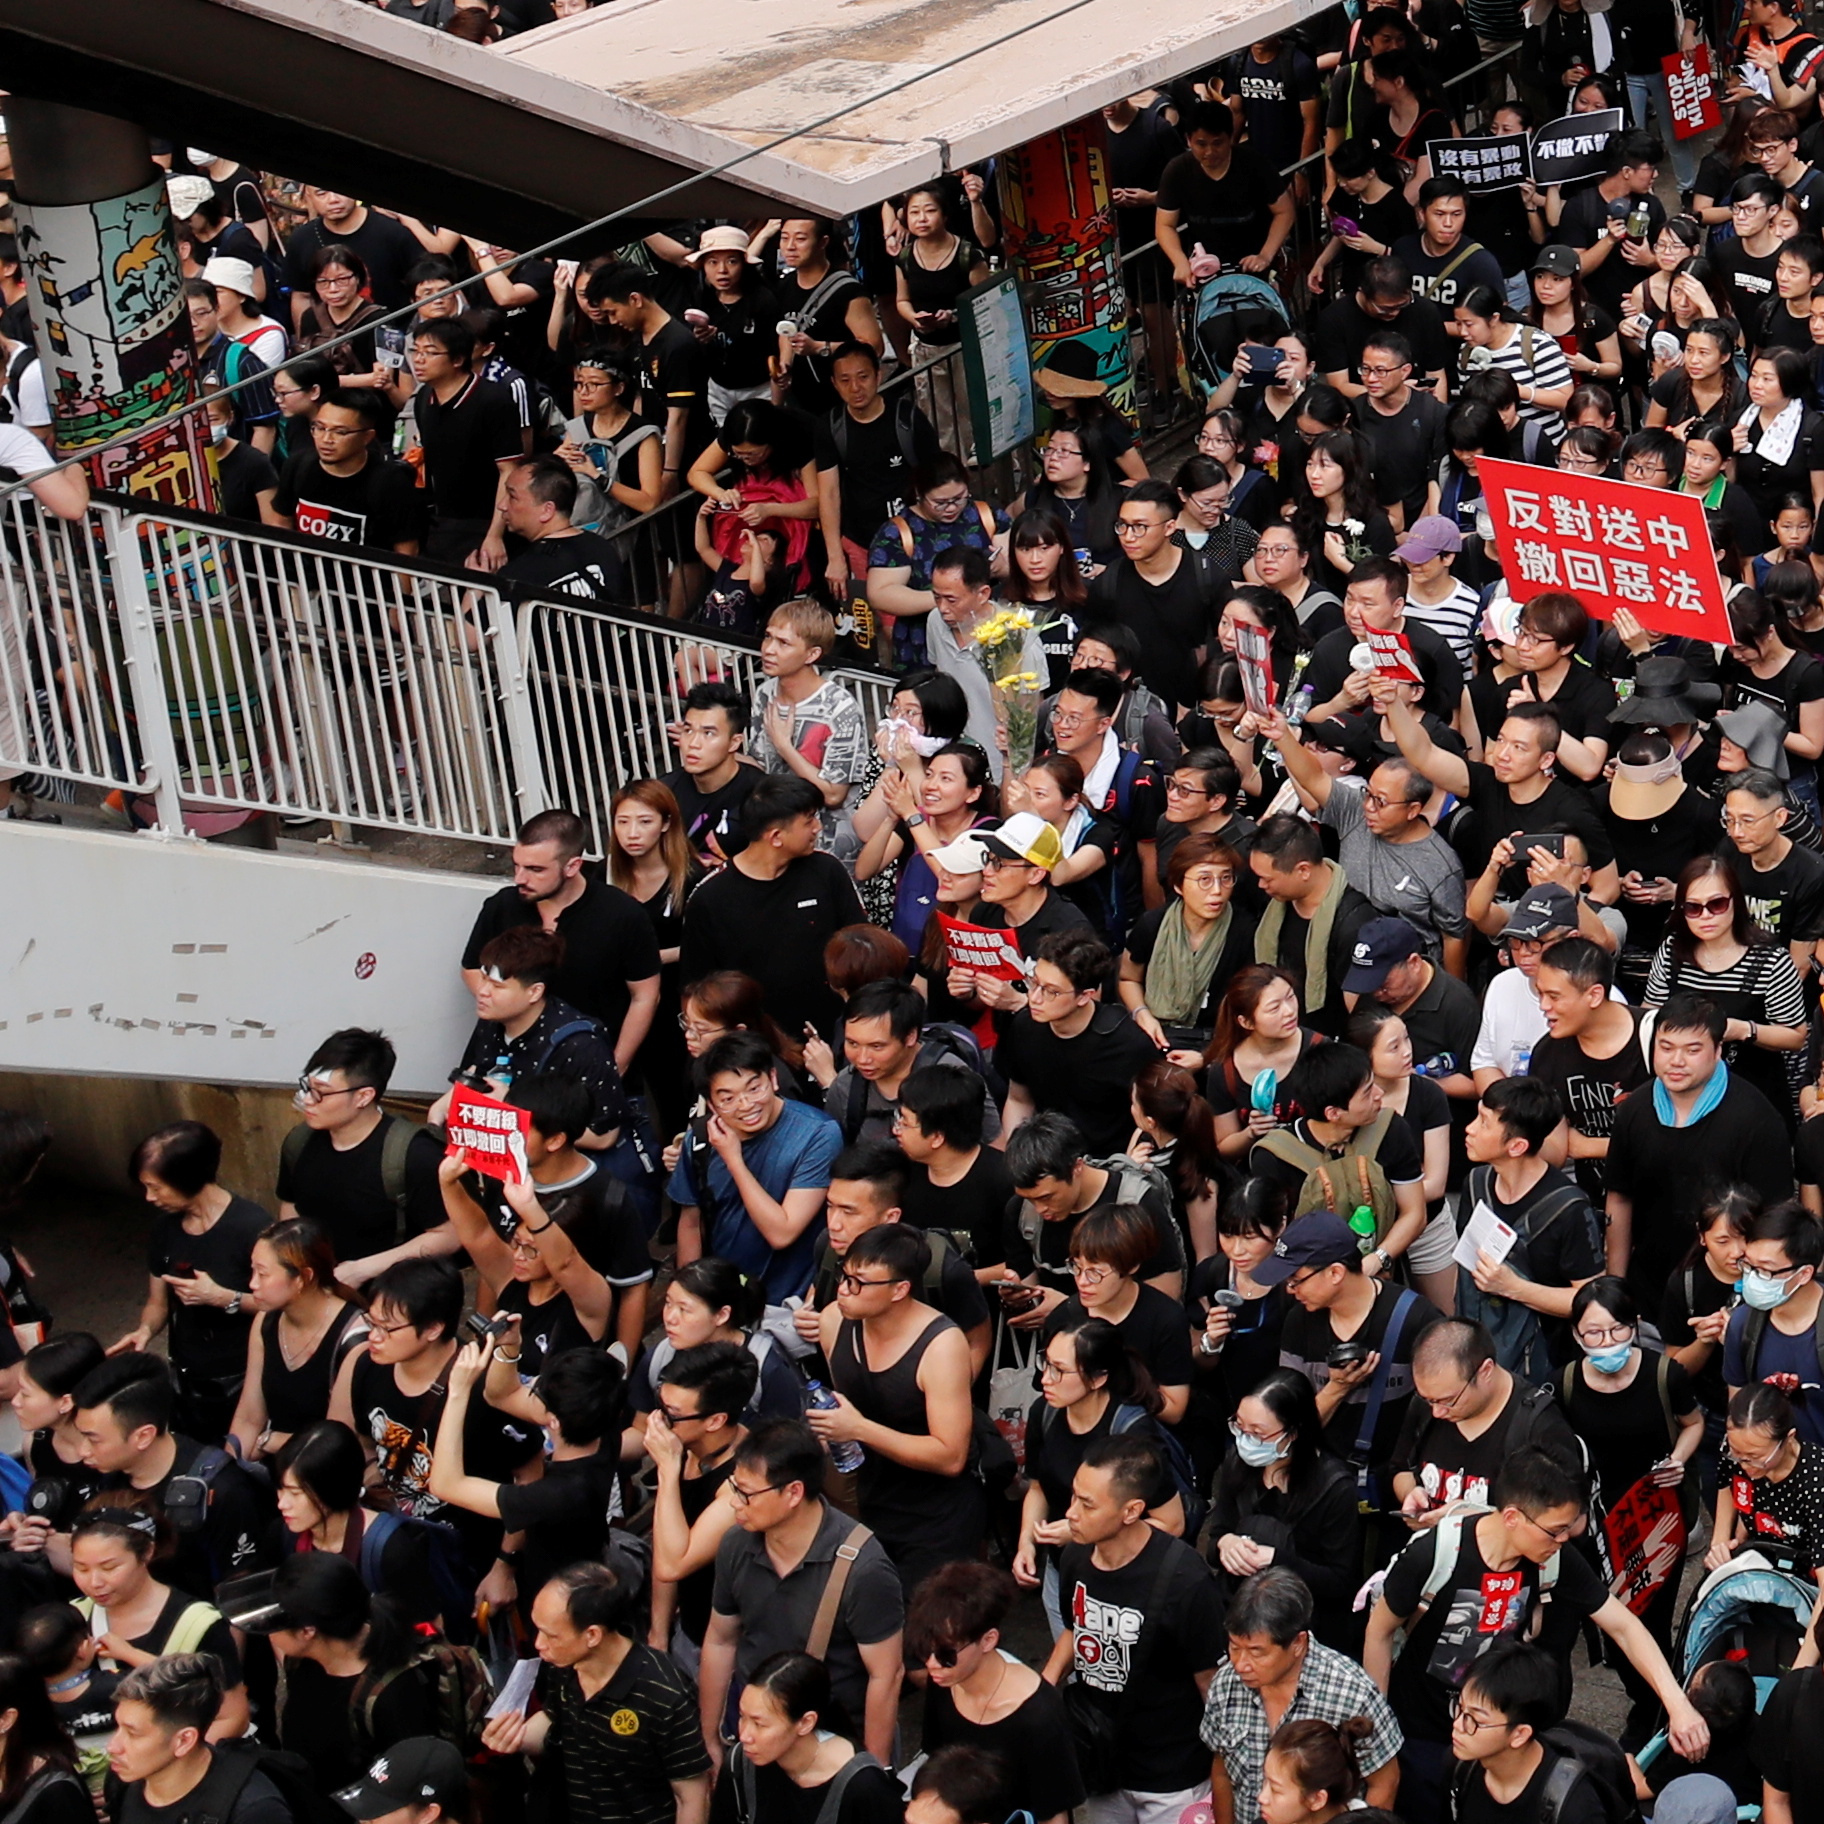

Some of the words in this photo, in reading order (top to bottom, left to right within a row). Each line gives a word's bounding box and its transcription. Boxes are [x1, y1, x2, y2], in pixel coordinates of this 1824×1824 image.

[1667, 73, 1687, 123] STOP
[1696, 73, 1711, 101] US
[1438, 144, 1521, 168] 沒有暴動
[299, 514, 355, 543] COZY
[1504, 487, 1690, 555] 反對送中
[1514, 539, 1704, 614] 撤回惡法
[948, 928, 1005, 948] 不要暫緩
[459, 1102, 518, 1131] 不要暫緩
[450, 1126, 508, 1154] 立即撤回
